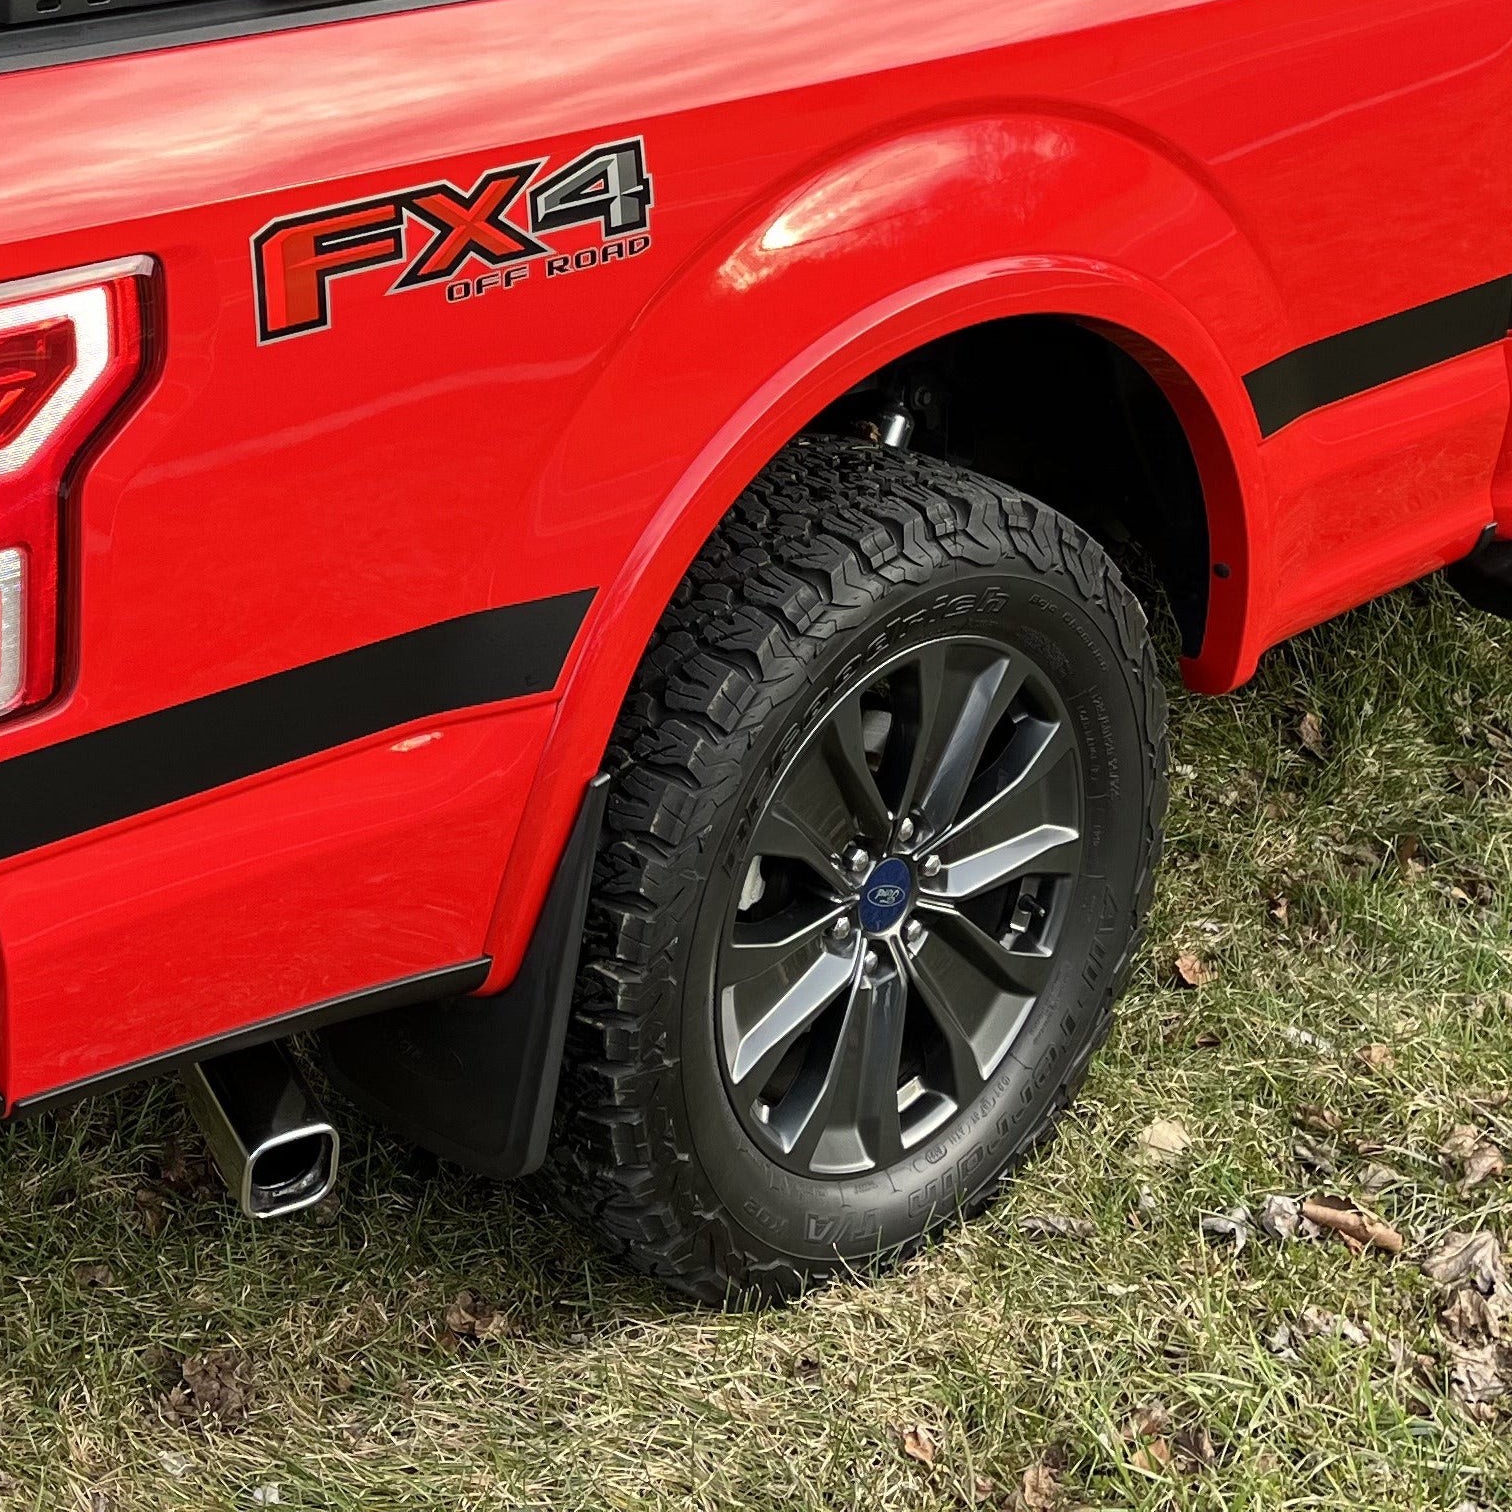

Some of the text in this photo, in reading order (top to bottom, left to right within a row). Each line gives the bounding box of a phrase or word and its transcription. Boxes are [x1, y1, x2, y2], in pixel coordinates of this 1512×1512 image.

[249, 134, 655, 347] FX4
[445, 234, 652, 304] OFF ROAD
